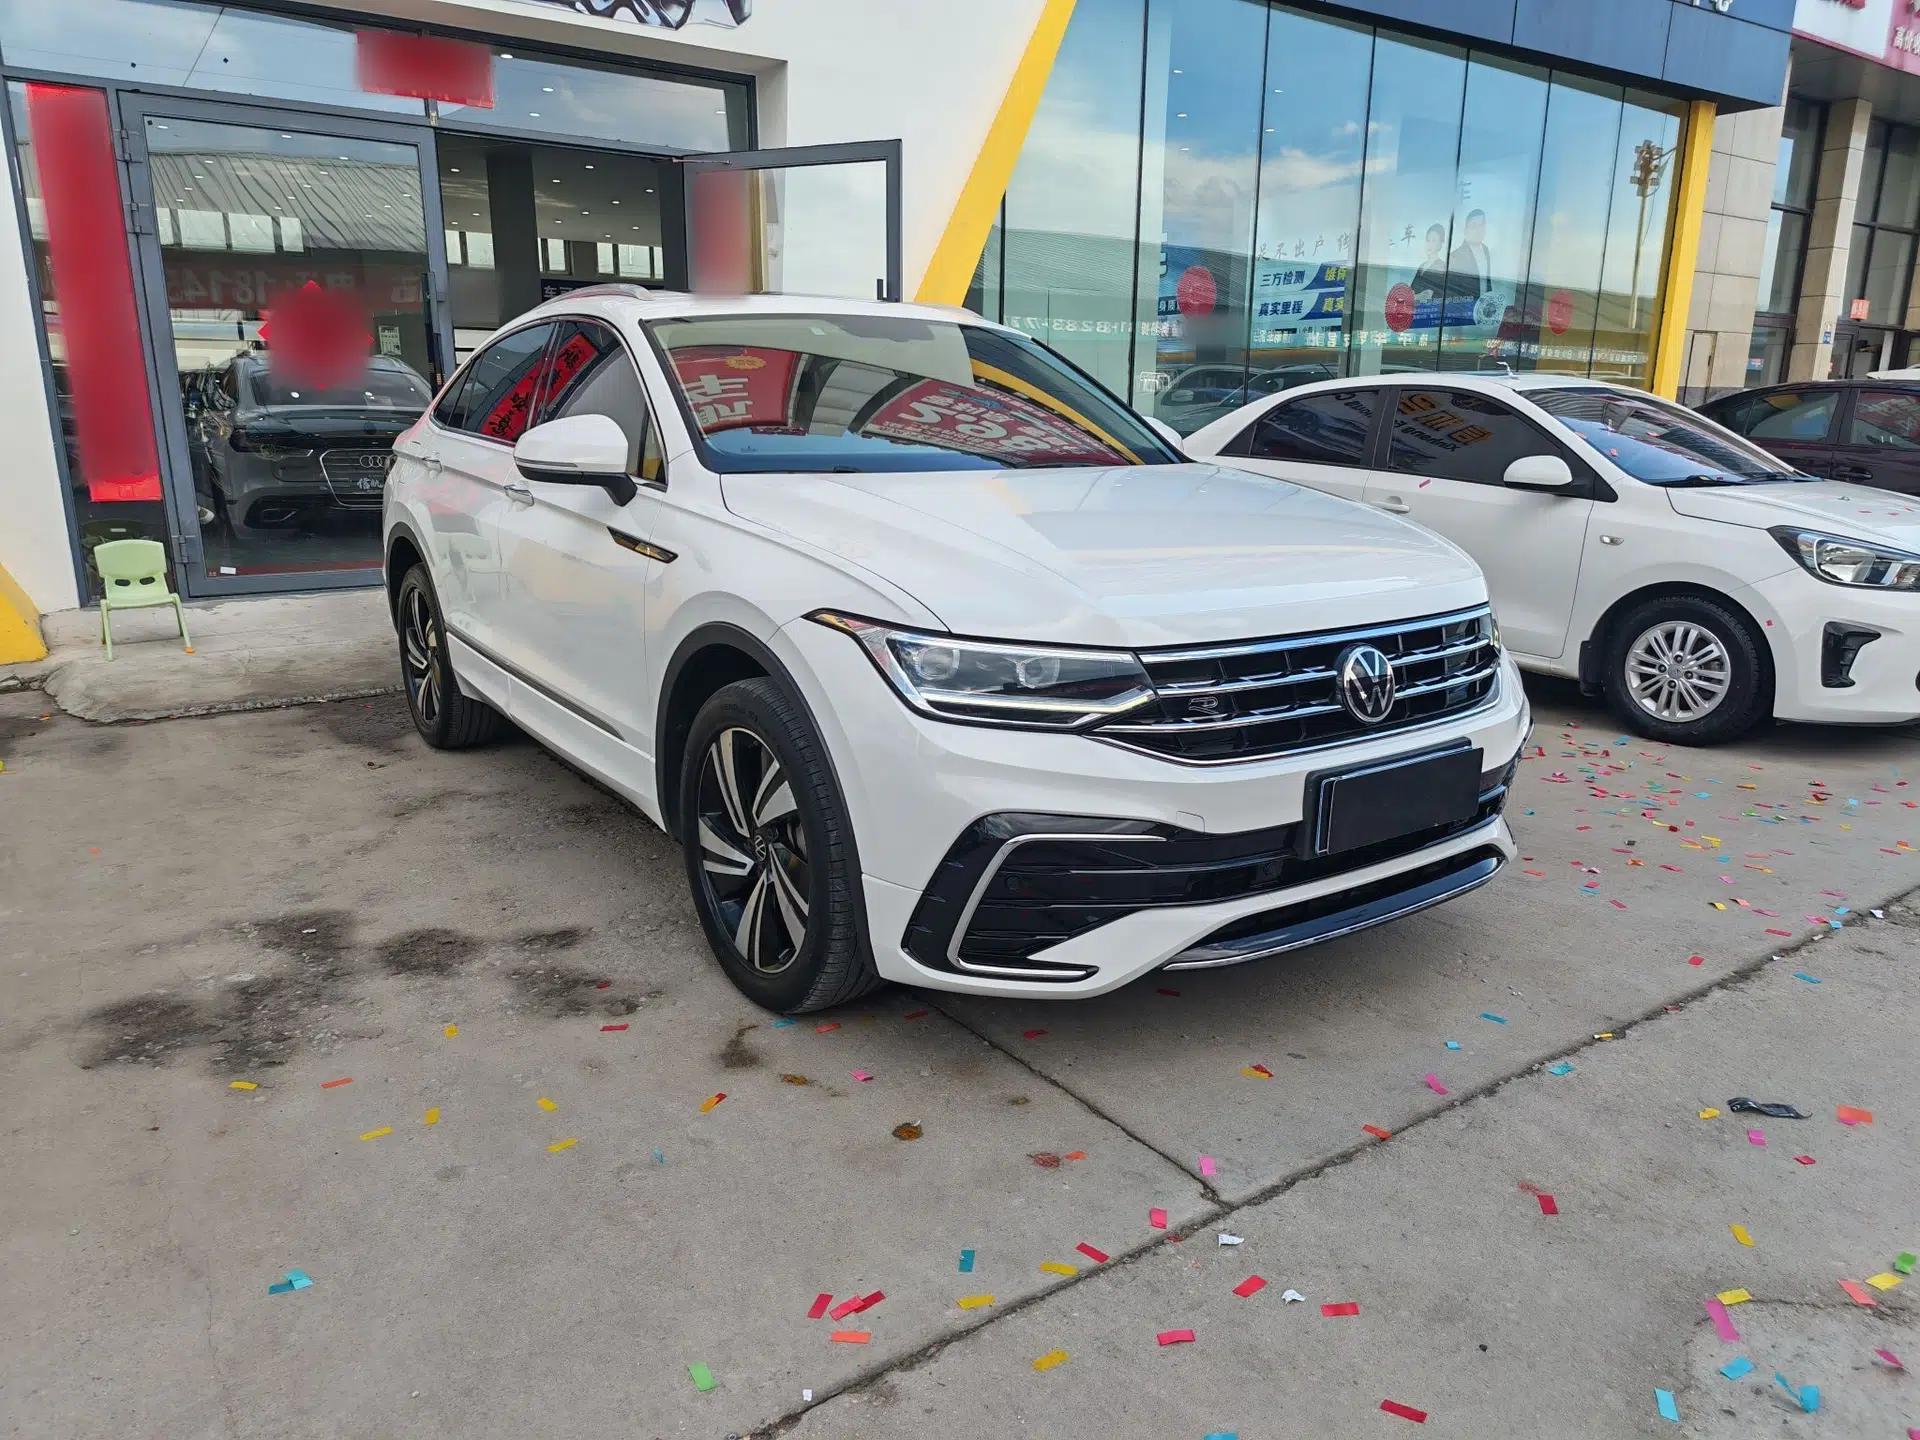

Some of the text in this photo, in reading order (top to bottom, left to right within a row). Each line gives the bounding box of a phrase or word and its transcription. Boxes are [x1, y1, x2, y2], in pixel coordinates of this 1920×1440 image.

[1260, 270, 1305, 288] 三方检测
[1258, 299, 1304, 317] 真实里程
